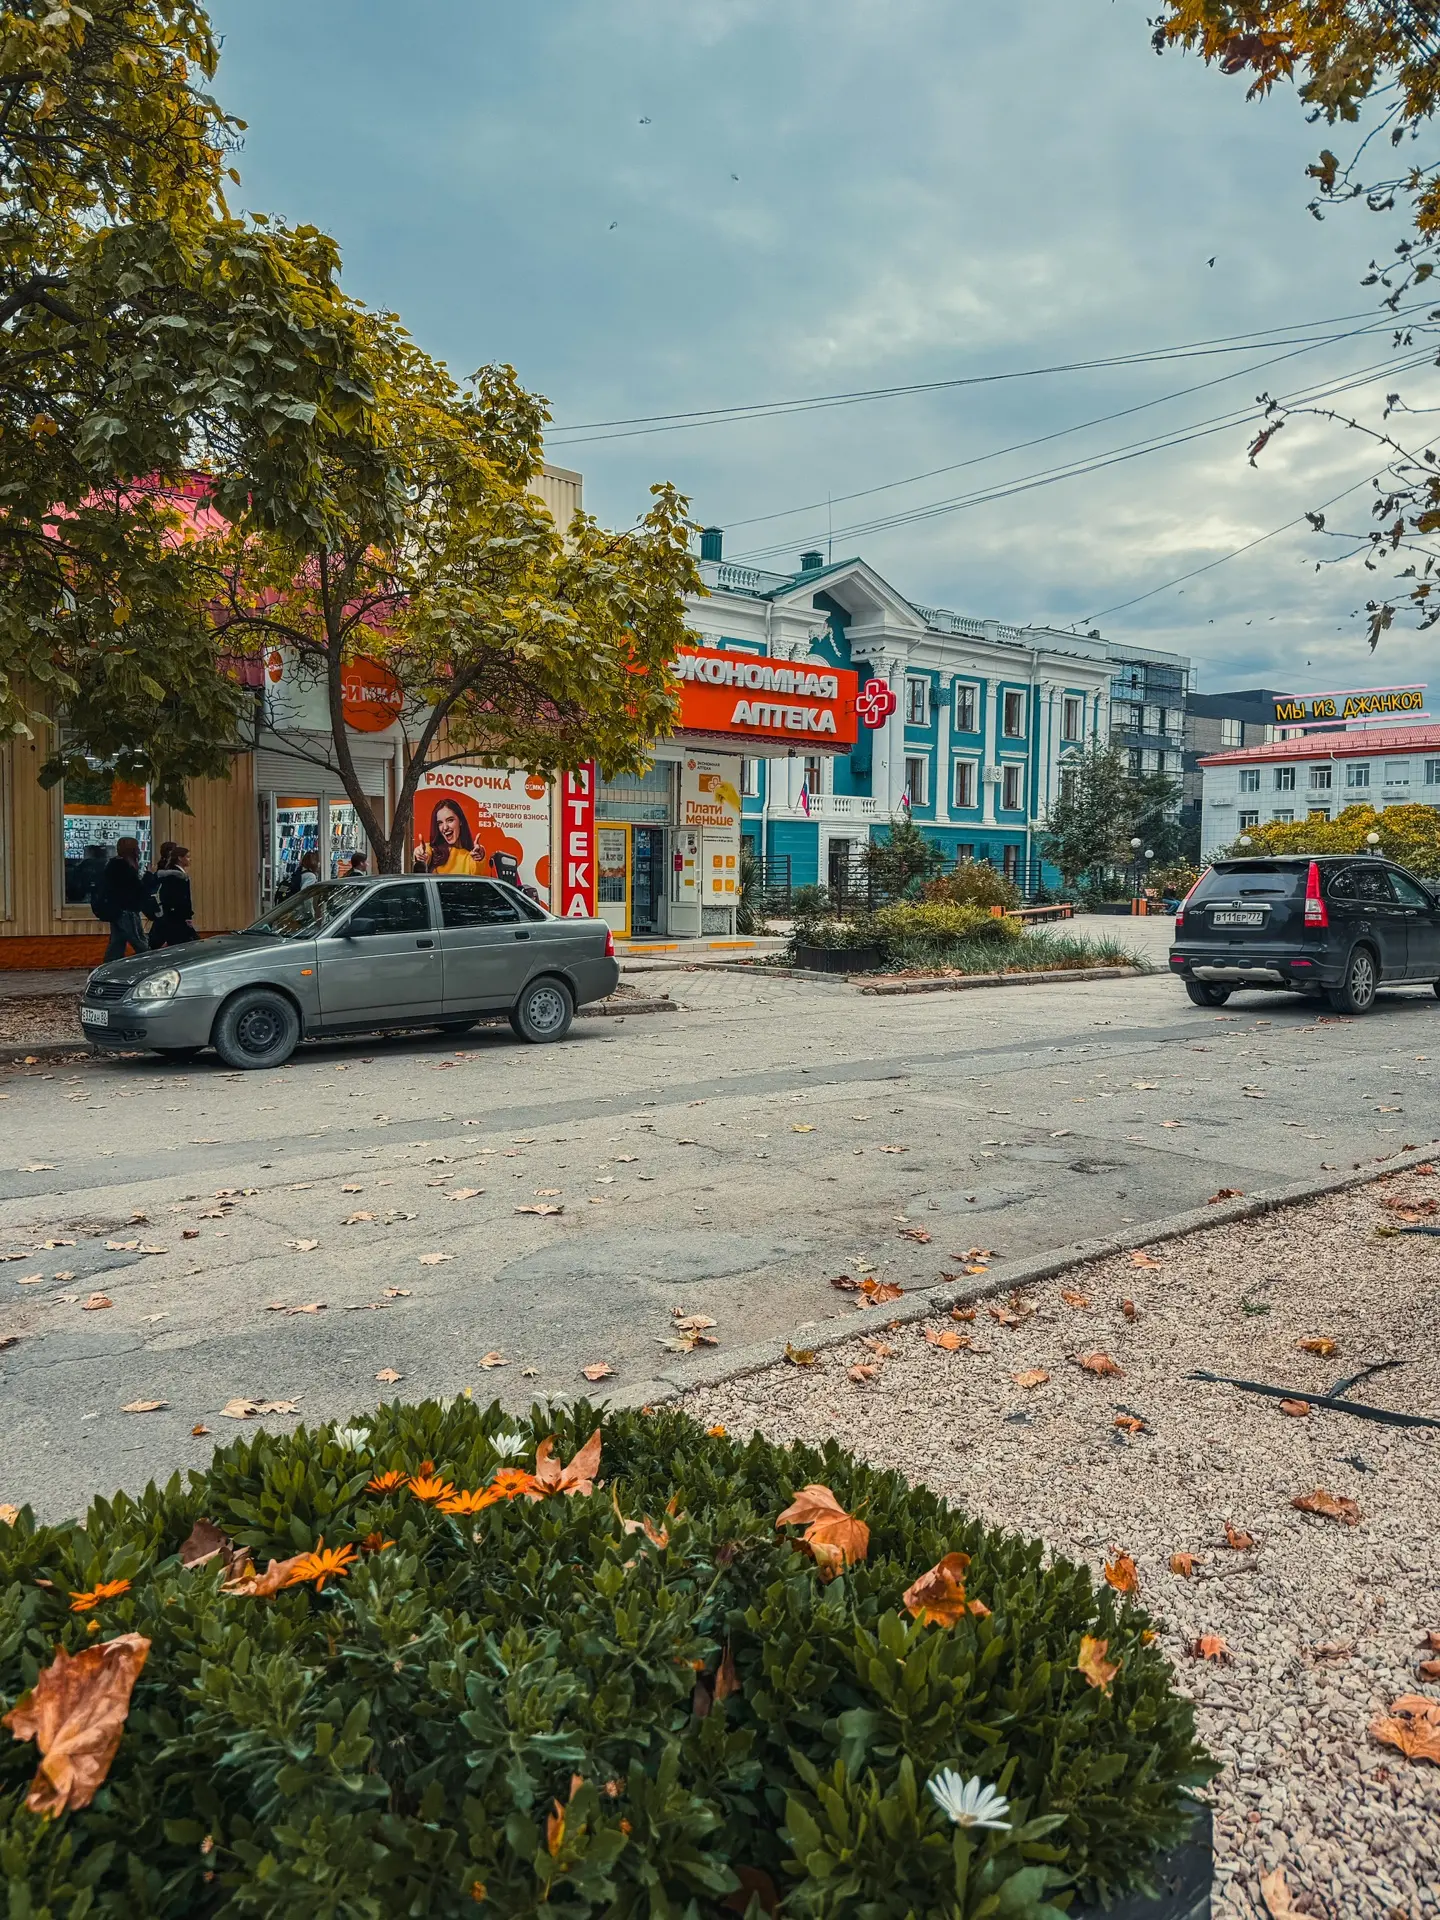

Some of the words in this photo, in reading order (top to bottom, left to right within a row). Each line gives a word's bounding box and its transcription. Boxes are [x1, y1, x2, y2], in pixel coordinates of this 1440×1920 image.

[667, 654, 838, 699] ЭКОНОМНАЯ
[731, 700, 837, 733] АПТЕКА
[426, 773, 512, 790] РАССРОЧКА
[492, 803, 531, 811] ПРОЦЕНТОВ
[686, 800, 723, 814] Плати
[493, 812, 522, 820] ПЕРВОГО
[523, 813, 549, 821] ВЗНОСА
[686, 814, 734, 826] меньше
[478, 820, 492, 828] БЕЗ
[492, 820, 523, 829] УСЛОВИЙ
[565, 757, 591, 918] ПТЕКА
